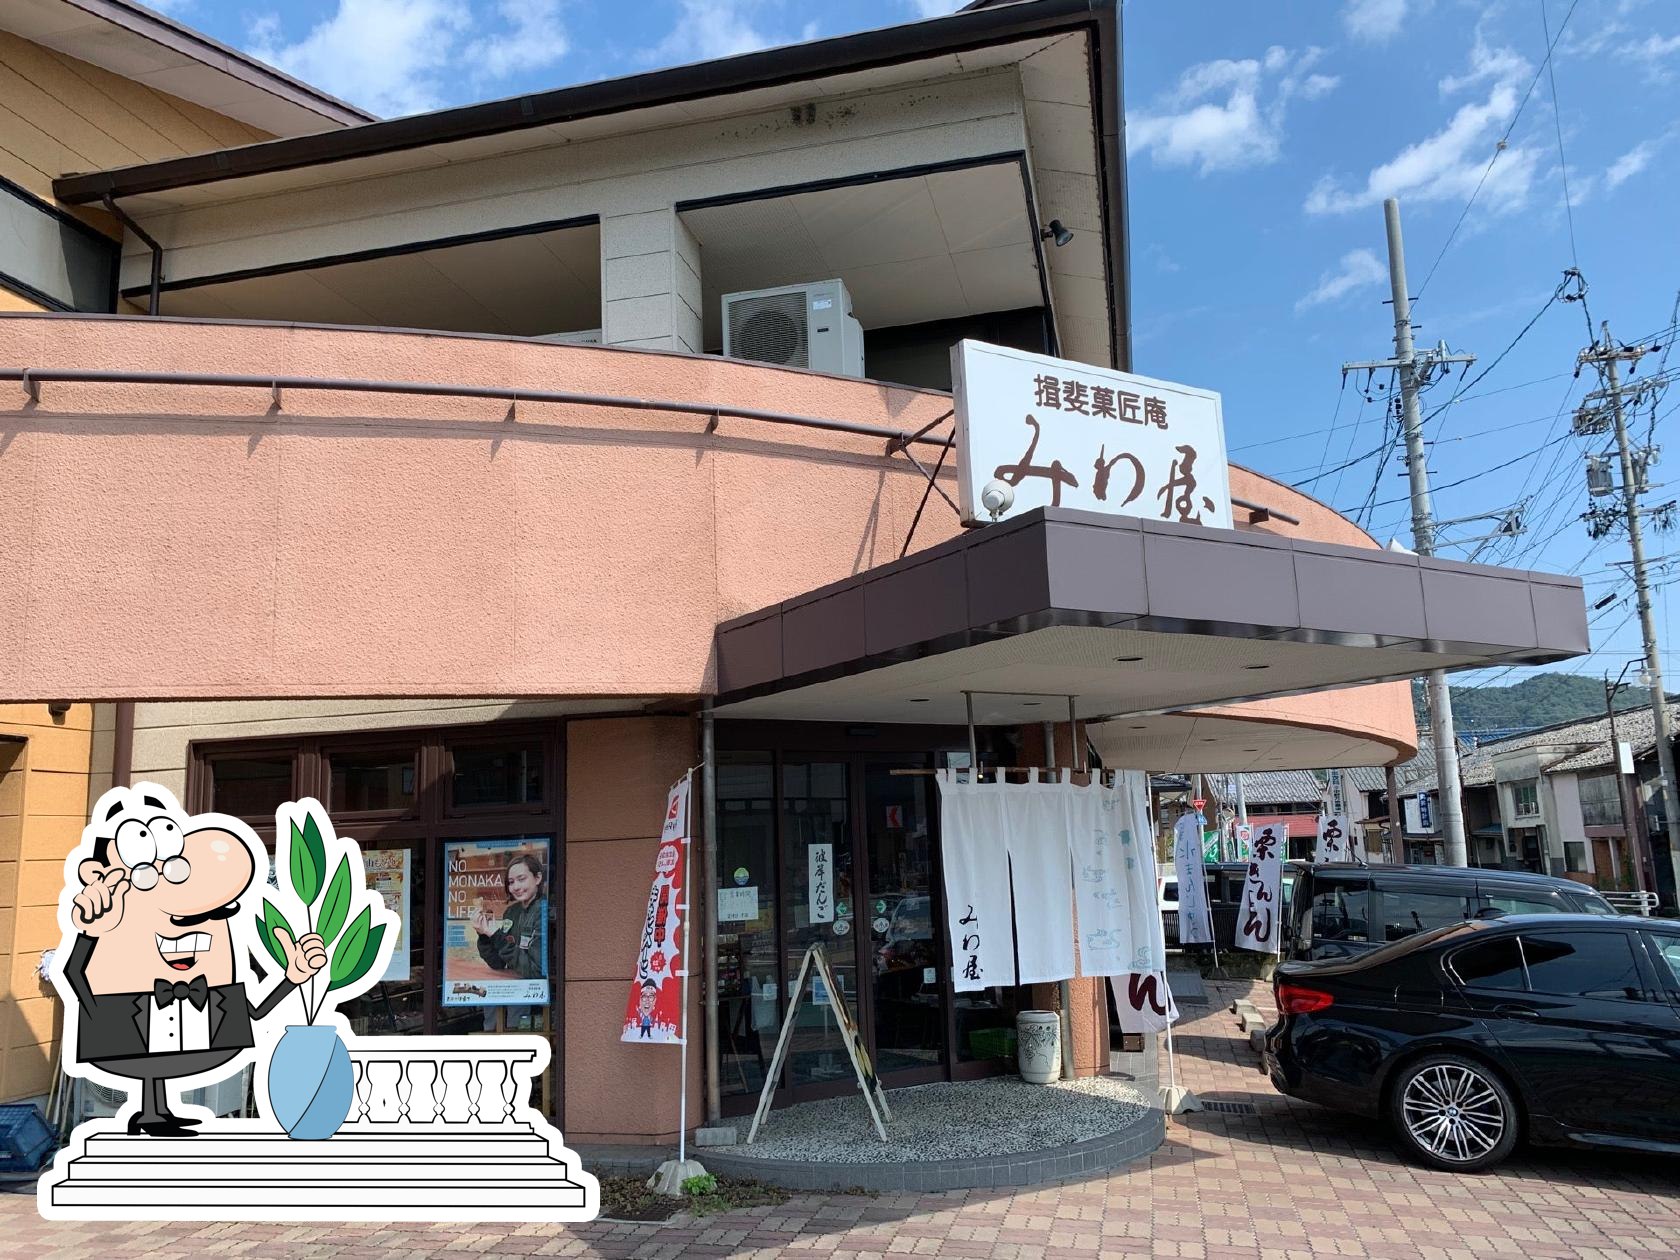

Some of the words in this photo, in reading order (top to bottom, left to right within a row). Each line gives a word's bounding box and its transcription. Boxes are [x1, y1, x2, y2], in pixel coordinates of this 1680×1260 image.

[1033, 373, 1168, 430] 揖斐菓匠庵
[993, 414, 1215, 526] みわ屋
[448, 859, 467, 873] NO
[448, 873, 503, 888] MONAKA
[814, 849, 828, 919] 彼岸だんご
[448, 890, 467, 903] NO
[958, 904, 984, 981] みわ屋
